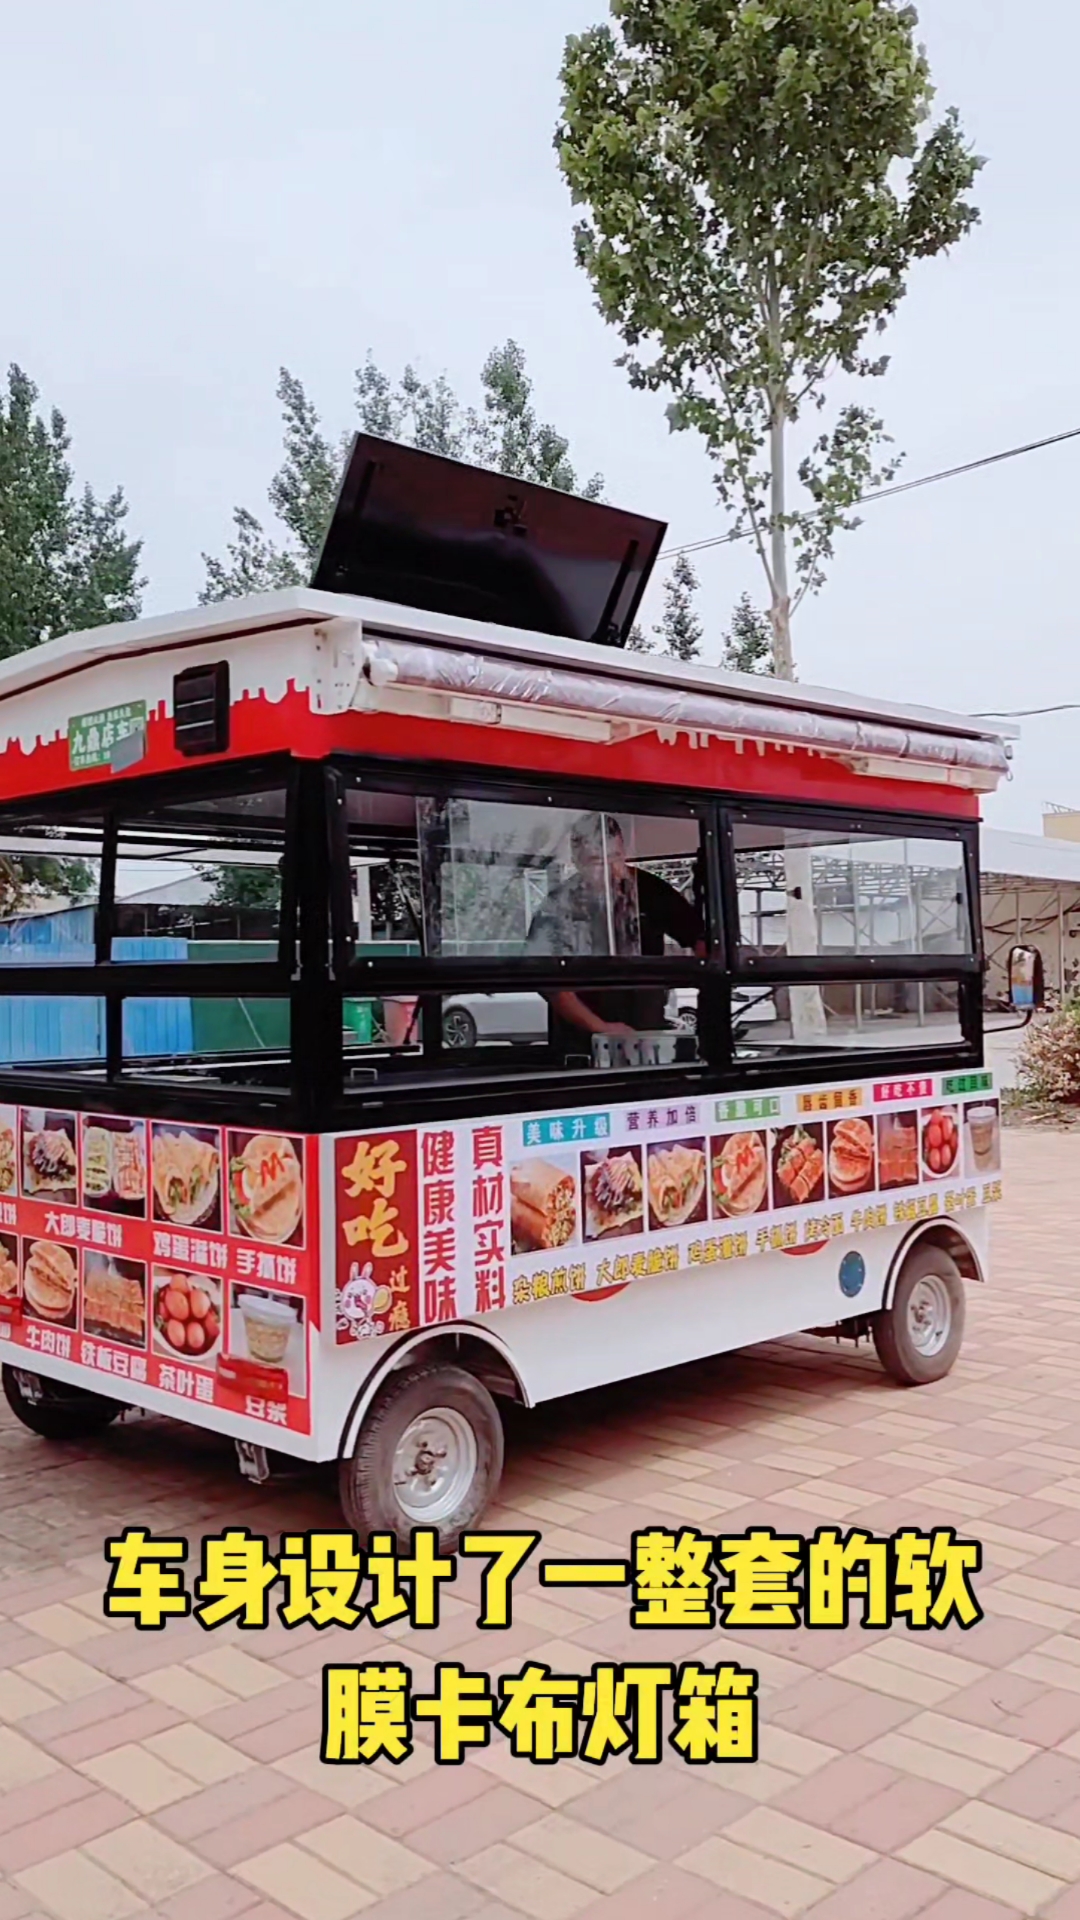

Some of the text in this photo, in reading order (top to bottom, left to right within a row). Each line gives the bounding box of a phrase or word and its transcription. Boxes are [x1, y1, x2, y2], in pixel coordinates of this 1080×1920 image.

[526, 1118, 609, 1145] 美味升级
[627, 1106, 697, 1131] 营养加倍
[341, 1139, 409, 1257] 好吃
[421, 1130, 457, 1323] 健康美味
[471, 1125, 506, 1313] 真材实料
[153, 1231, 229, 1270] 鸡蛋灌饼
[236, 1248, 297, 1285] 手抓饼
[512, 1261, 586, 1304] 杂粮煎饼
[756, 1220, 798, 1252] 手抓饼
[389, 1265, 411, 1331] 过瘾
[26, 1325, 71, 1359] 牛肉饼
[80, 1340, 148, 1383] 铁板豆腐
[158, 1363, 215, 1404] 茶叶蛋
